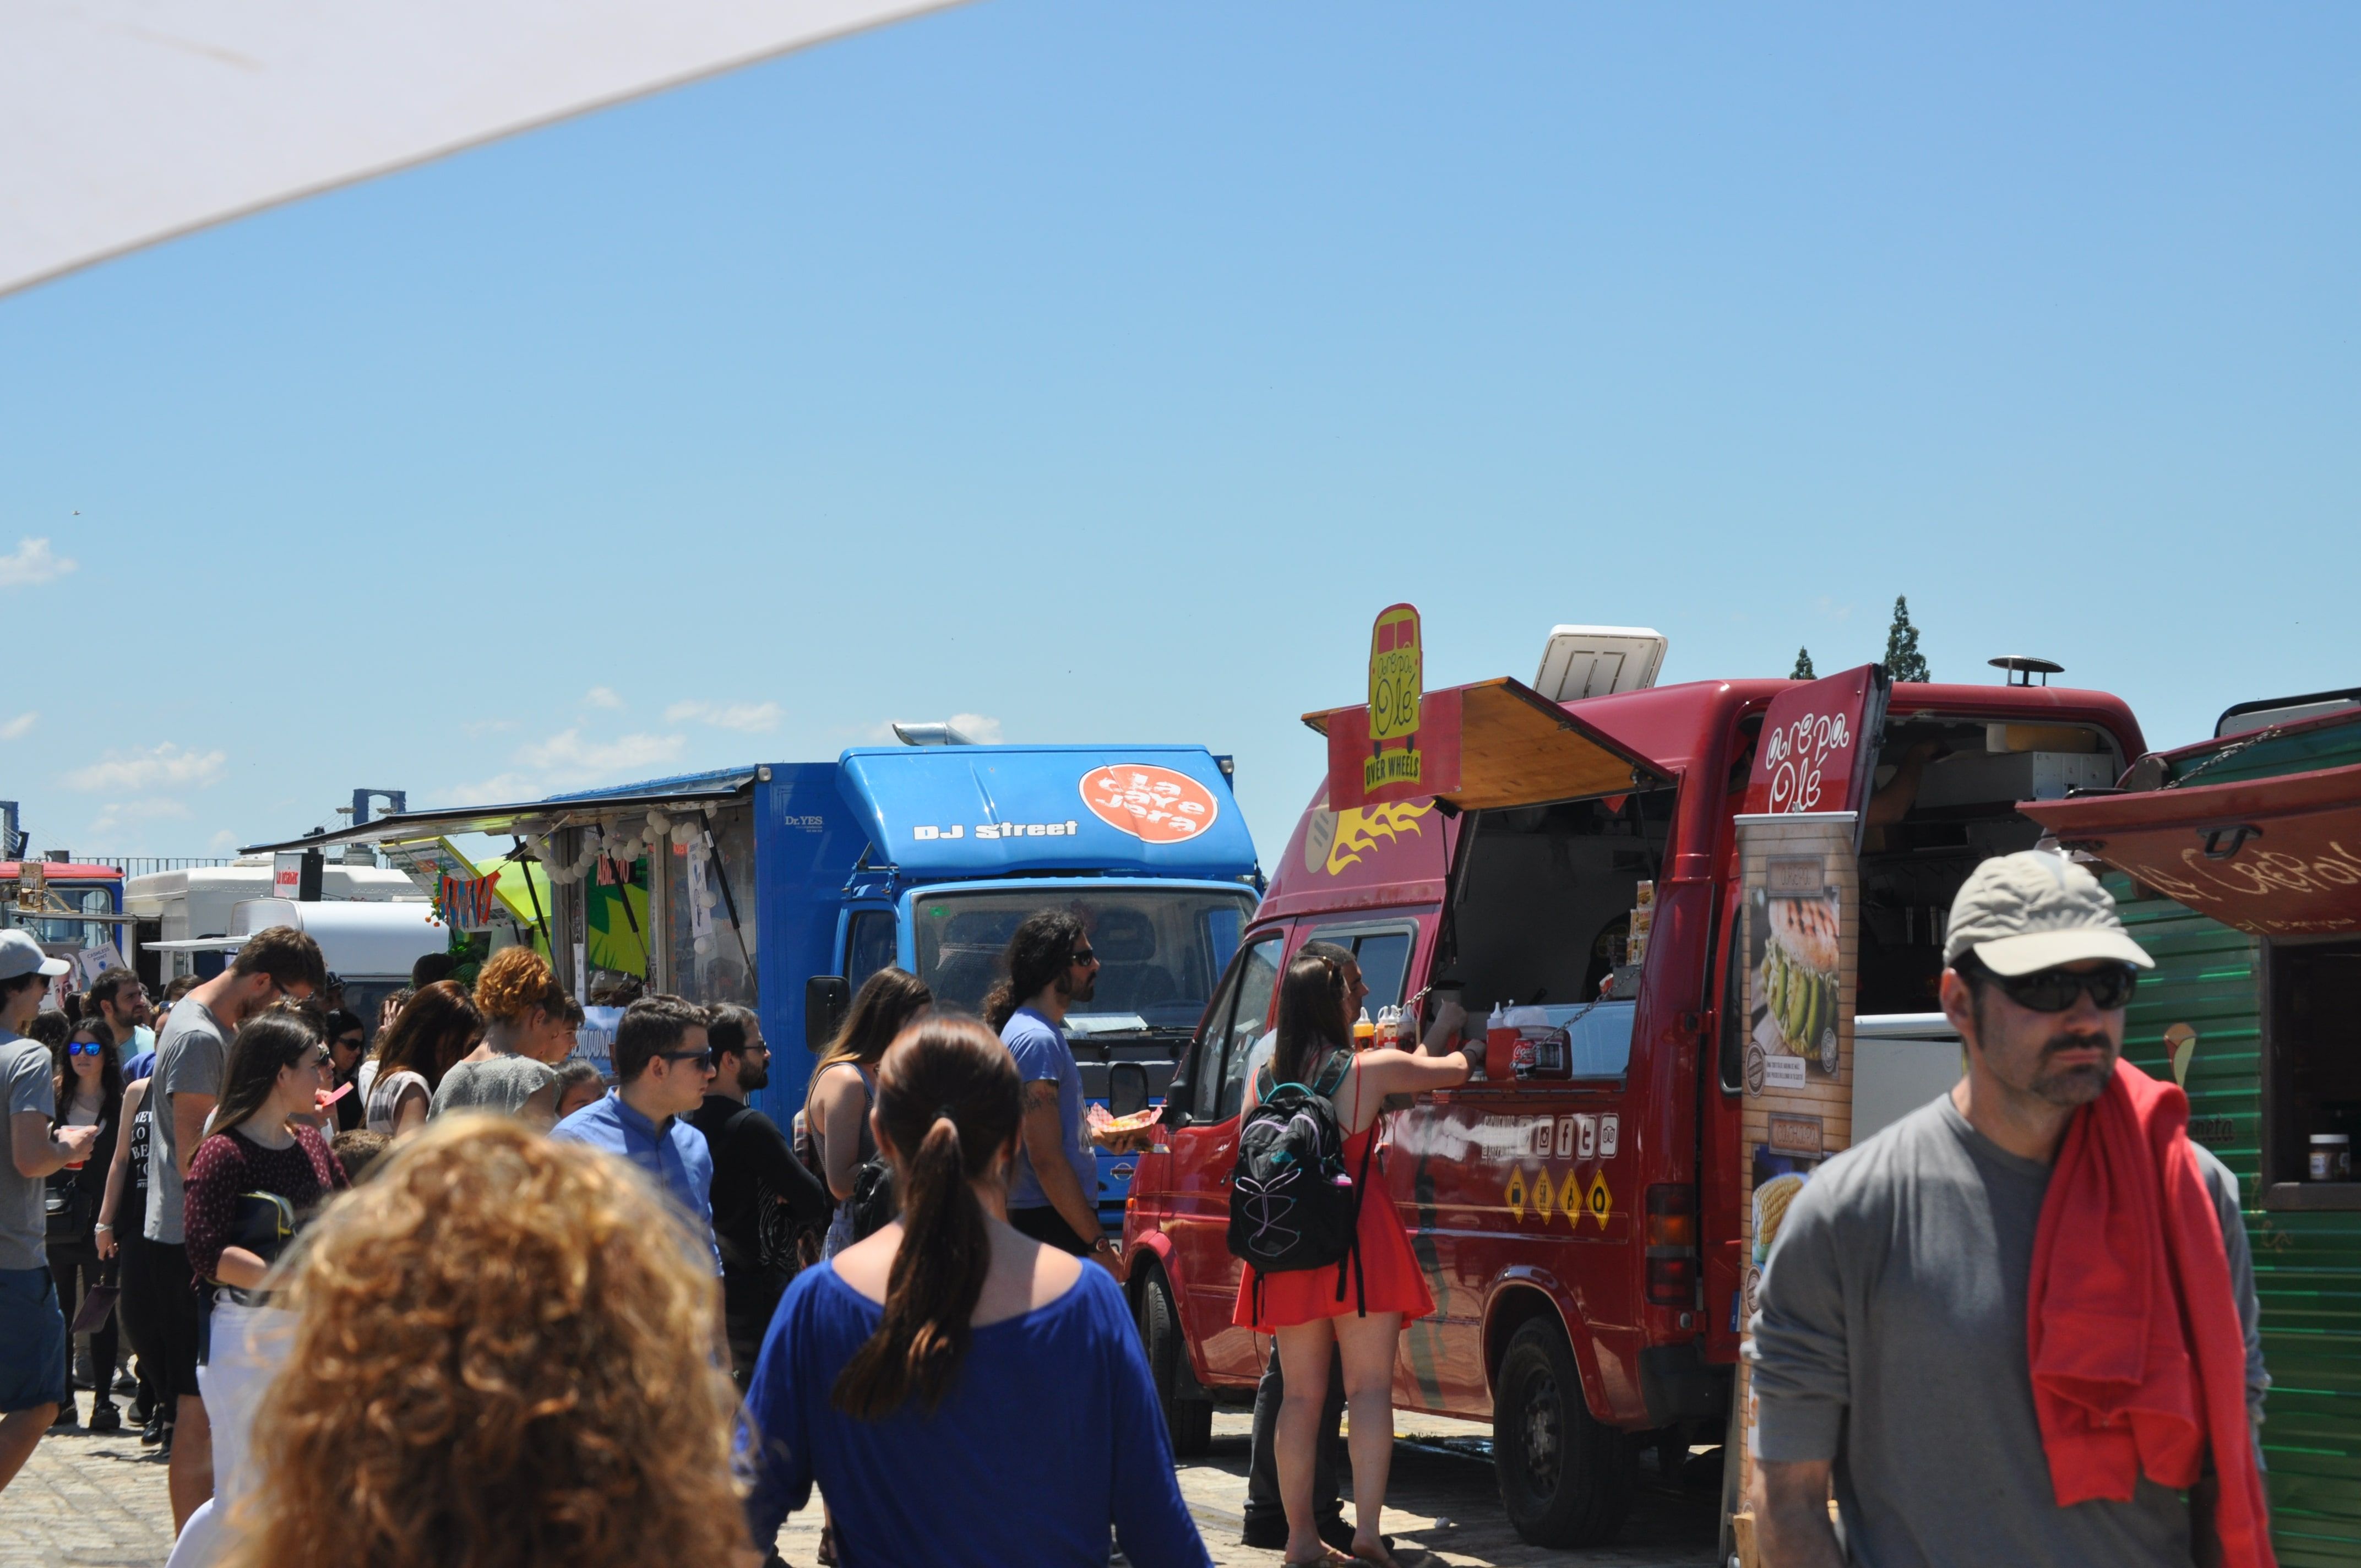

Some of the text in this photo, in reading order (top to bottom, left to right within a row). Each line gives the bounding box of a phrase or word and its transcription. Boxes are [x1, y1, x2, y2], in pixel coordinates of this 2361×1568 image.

[1375, 673, 1415, 736] Olé
[1766, 712, 1849, 770] arepa
[1366, 755, 1419, 787] OVER WHEELS
[1769, 752, 1828, 814] Olé
[913, 820, 1078, 840] DJ Street
